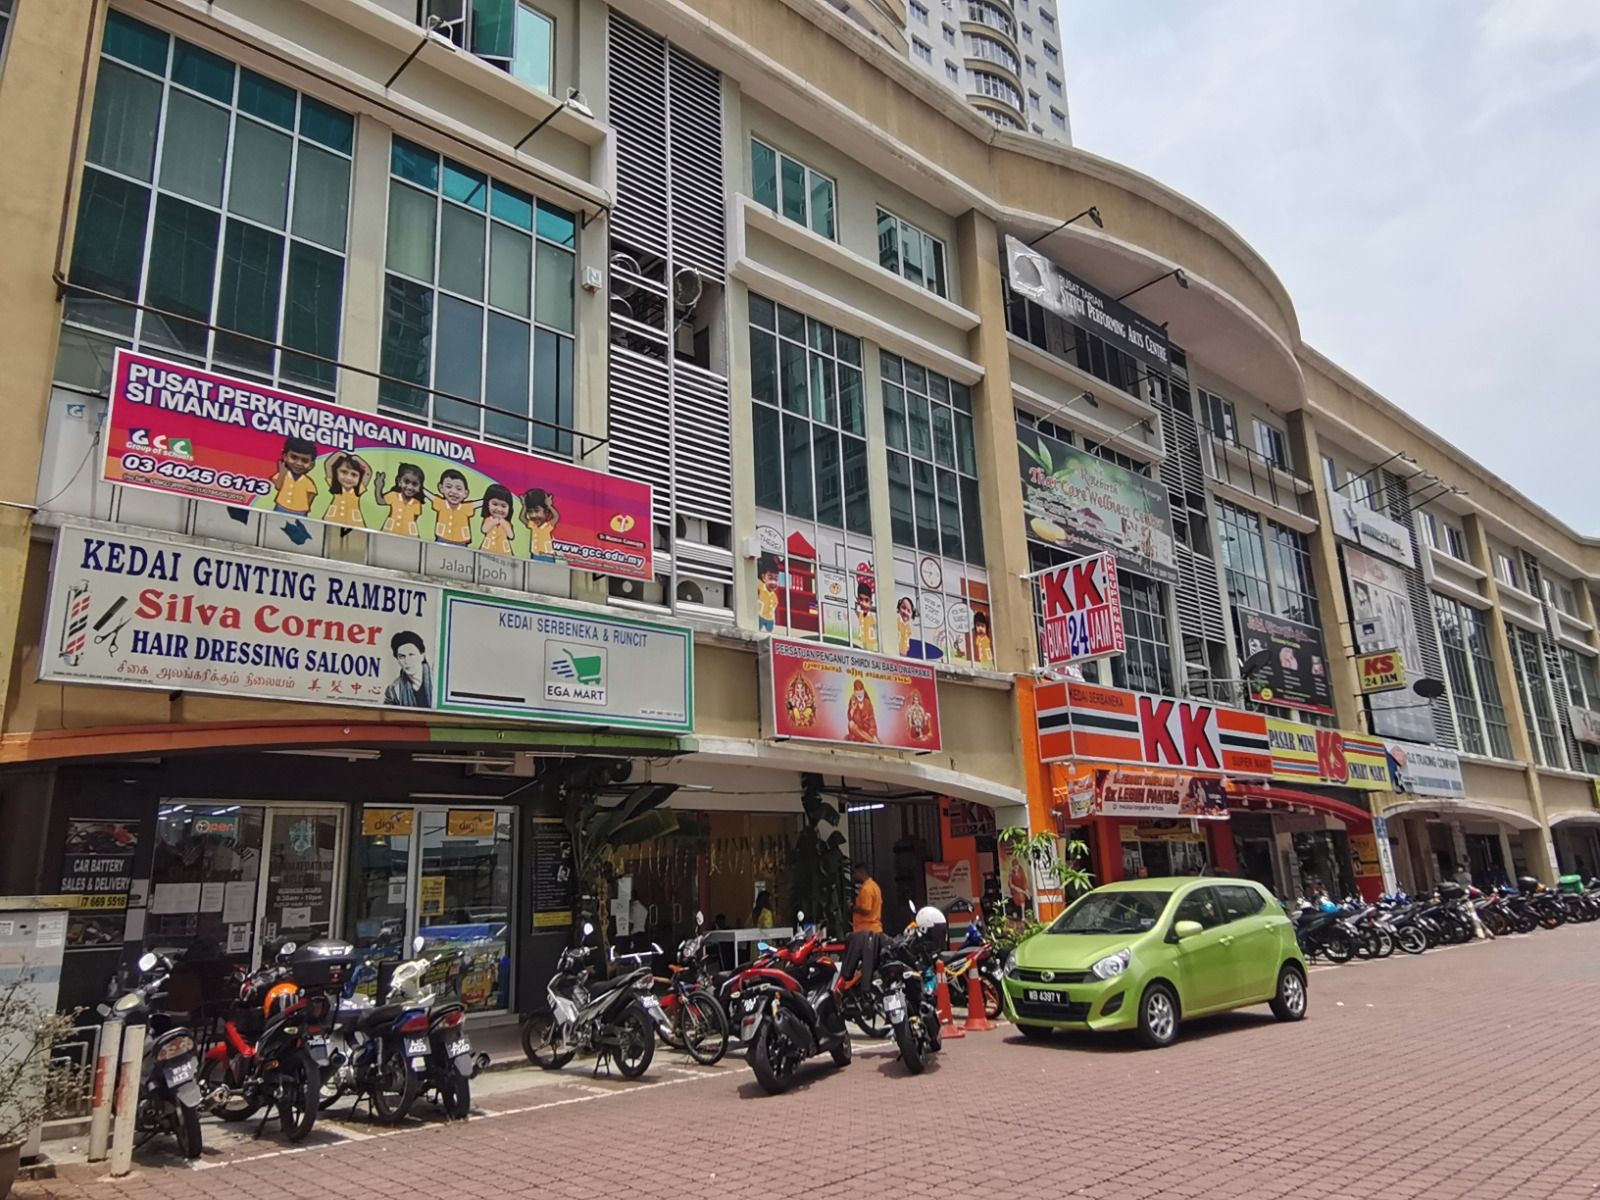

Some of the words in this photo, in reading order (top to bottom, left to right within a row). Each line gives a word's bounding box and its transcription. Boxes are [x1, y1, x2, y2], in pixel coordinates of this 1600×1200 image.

[1127, 325, 1144, 348] ARTS
[126, 381, 153, 405] SI
[159, 388, 247, 427] MANJA
[251, 412, 355, 451] CANGGIH
[129, 363, 212, 400] PUSAT
[217, 384, 407, 447] PERKEMBANGAN
[411, 433, 476, 464] MINDA
[124, 456, 153, 472] 03
[158, 463, 214, 485] 4045
[218, 474, 271, 495] 6113
[440, 558, 473, 575] Jalan
[553, 541, 644, 567] www.gcc.edu.my
[80, 538, 182, 582] KEDAI
[193, 556, 316, 602] GUNTING
[326, 577, 427, 617] RAMBUT
[1044, 558, 1104, 618] KK
[135, 588, 241, 629] Silva
[254, 604, 383, 645] Corner
[498, 611, 532, 631] KEDAI
[537, 616, 599, 641] SERBENEKA
[602, 629, 610, 642] &
[613, 630, 648, 648] RUNCIT
[1068, 612, 1089, 657] 24
[1089, 608, 1112, 649] JAM
[131, 630, 188, 658] HAIR
[193, 637, 299, 670] DRESSING
[305, 649, 381, 678] SALOON
[815, 649, 850, 665] PENGANUT
[881, 662, 899, 674] BABA
[1363, 655, 1394, 676] KS
[1364, 677, 1378, 687] 24
[1380, 673, 1398, 687] JAM
[547, 685, 570, 698] EGA
[573, 688, 604, 701] MART
[1139, 695, 1221, 769] KK
[1268, 729, 1296, 750] PASAR
[1232, 756, 1252, 767] SUPER
[1254, 757, 1271, 769] MART
[1315, 729, 1349, 784] KS
[1369, 766, 1387, 783] MART
[1118, 787, 1145, 803] LEBIH
[1146, 788, 1180, 805] PANTAS
[374, 819, 395, 832] digi
[73, 859, 90, 873] CAR
[91, 859, 125, 873] BATTERY
[61, 878, 86, 891] SALES
[86, 879, 92, 891] &
[94, 877, 131, 891] DELIVERY
